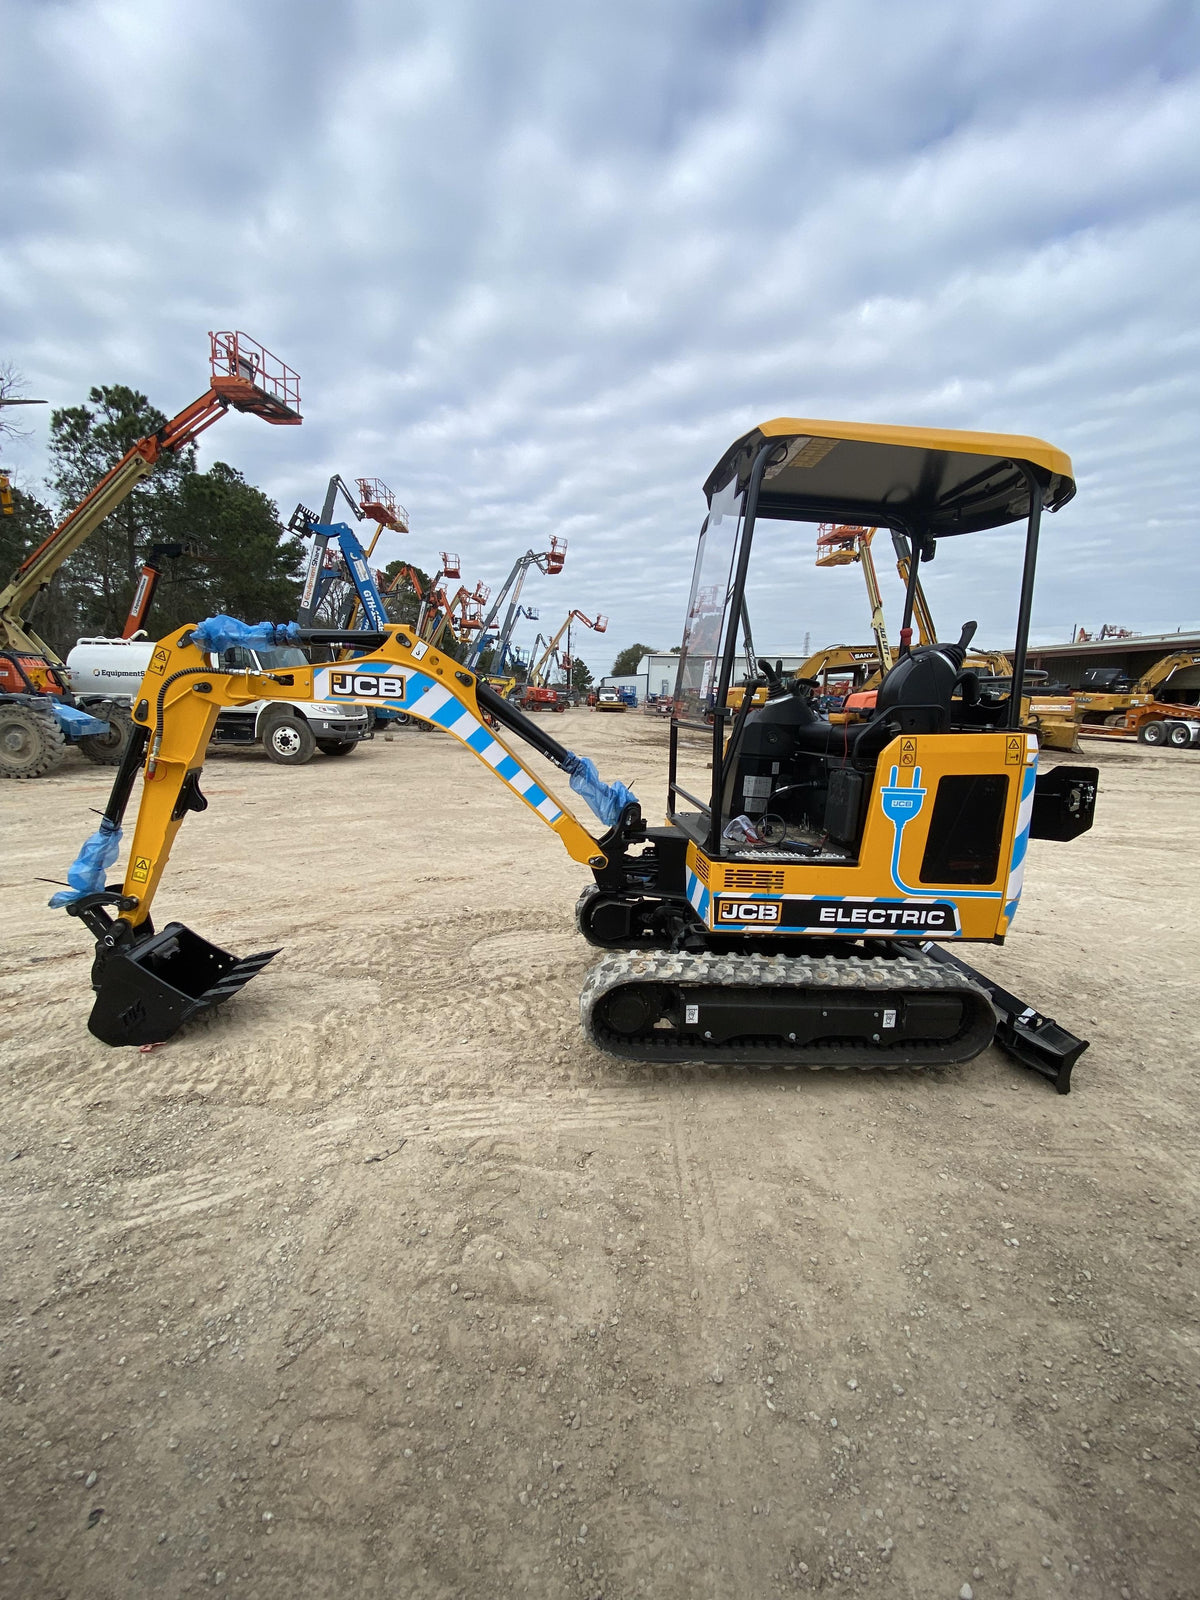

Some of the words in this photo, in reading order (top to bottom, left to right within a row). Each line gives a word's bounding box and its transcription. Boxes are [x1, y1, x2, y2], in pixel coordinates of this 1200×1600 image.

[882, 640, 890, 656] LIFT
[333, 675, 403, 698] JCB
[892, 800, 912, 808] JCB
[722, 903, 778, 921] JCB
[819, 907, 945, 925] ELECTRIC
